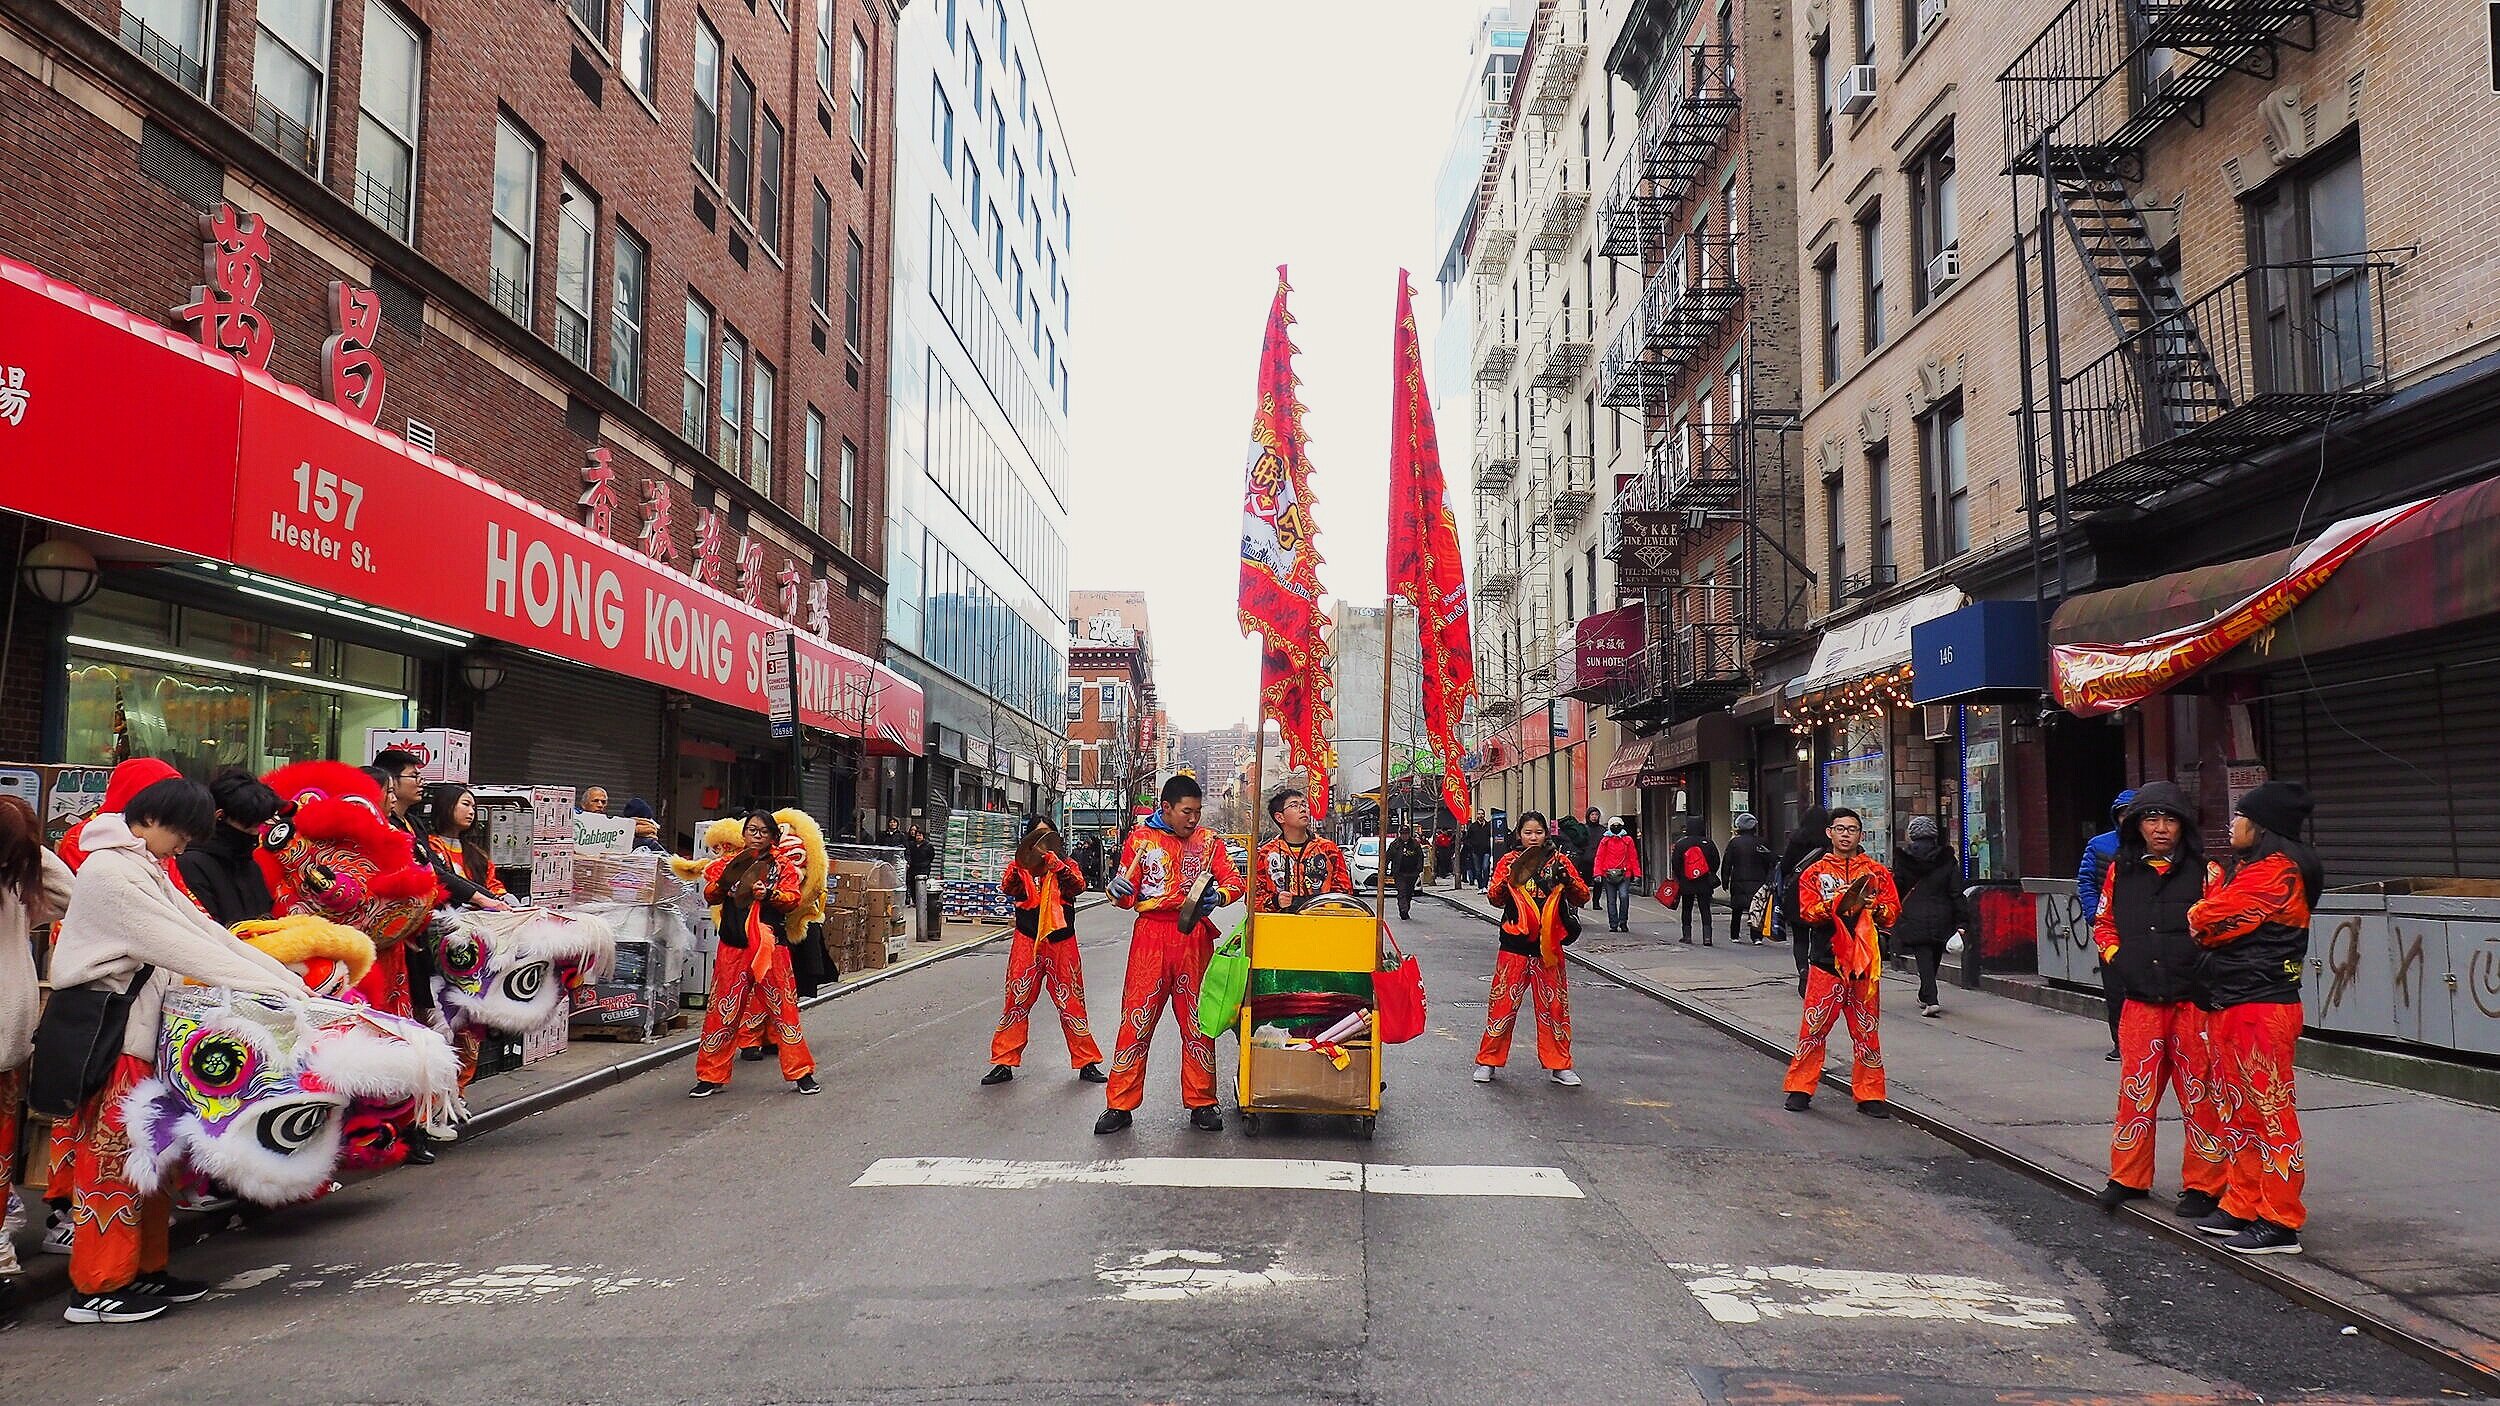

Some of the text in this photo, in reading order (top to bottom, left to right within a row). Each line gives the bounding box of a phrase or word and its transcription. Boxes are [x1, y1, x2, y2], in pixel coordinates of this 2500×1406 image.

[292, 460, 365, 532] 157
[1651, 524, 1678, 535] K & E
[271, 510, 377, 573] Hester St.
[1624, 537, 1680, 546] FINE JEWELRY
[485, 520, 881, 727] HONG KONG SRMARKET
[1586, 656, 1626, 667] SUN HOTEL
[1939, 646, 1953, 665] 146
[768, 661, 775, 673] 3
[769, 677, 789, 685] COMMERCIA
[908, 706, 920, 730] 157
[578, 828, 618, 849] Cabbage
[601, 1008, 640, 1022] Potatoes
